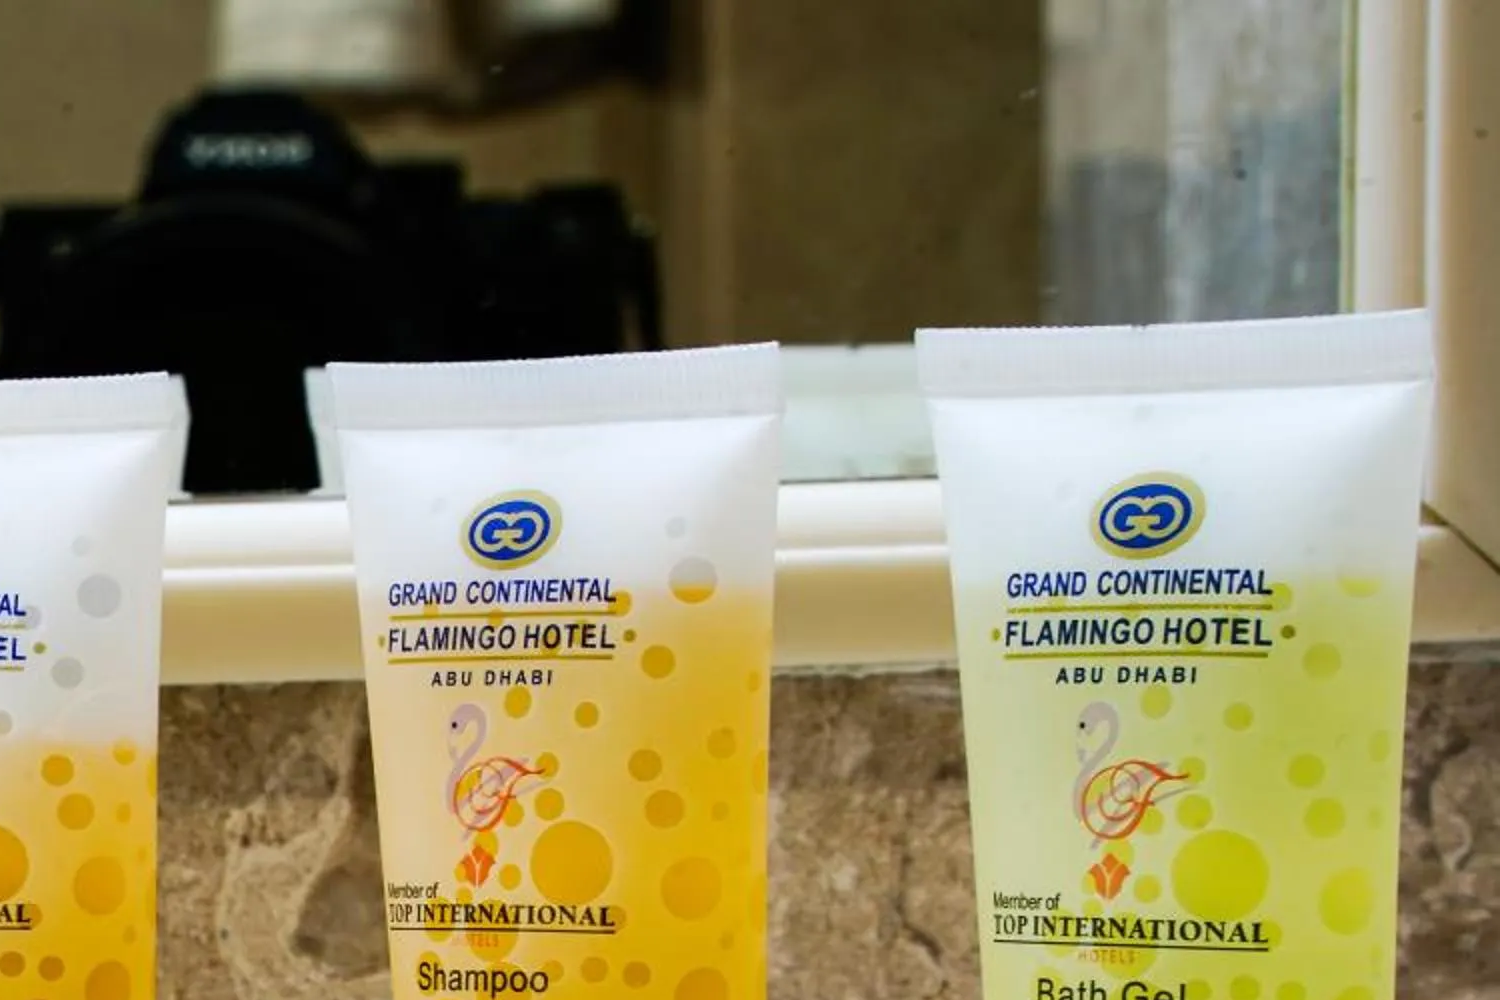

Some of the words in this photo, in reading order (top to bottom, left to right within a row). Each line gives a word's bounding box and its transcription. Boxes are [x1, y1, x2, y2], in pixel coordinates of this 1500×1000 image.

[389, 581, 457, 607] GRAND
[466, 577, 618, 604] CONTINENTAL
[1007, 572, 1087, 598] GRAND
[1098, 569, 1273, 596] CONTINENTAL
[389, 624, 517, 653] FLAMINGO
[523, 623, 617, 649] HOTEL
[1005, 617, 1154, 647] FLAMINGO
[1162, 617, 1272, 646] HOTEL
[431, 671, 473, 687] ABU
[484, 669, 553, 686] DHABI
[1056, 667, 1104, 685] ABU
[1117, 666, 1197, 684] DHABI
[425, 882, 439, 899] of
[993, 892, 1043, 910] Member
[1045, 892, 1061, 911] of
[417, 903, 616, 927] INTERNATIONAL
[993, 914, 1029, 936] TOP
[1033, 916, 1268, 943] INTERNATIONAL
[1078, 950, 1136, 965] HOTELS
[418, 961, 549, 999] Shampoo
